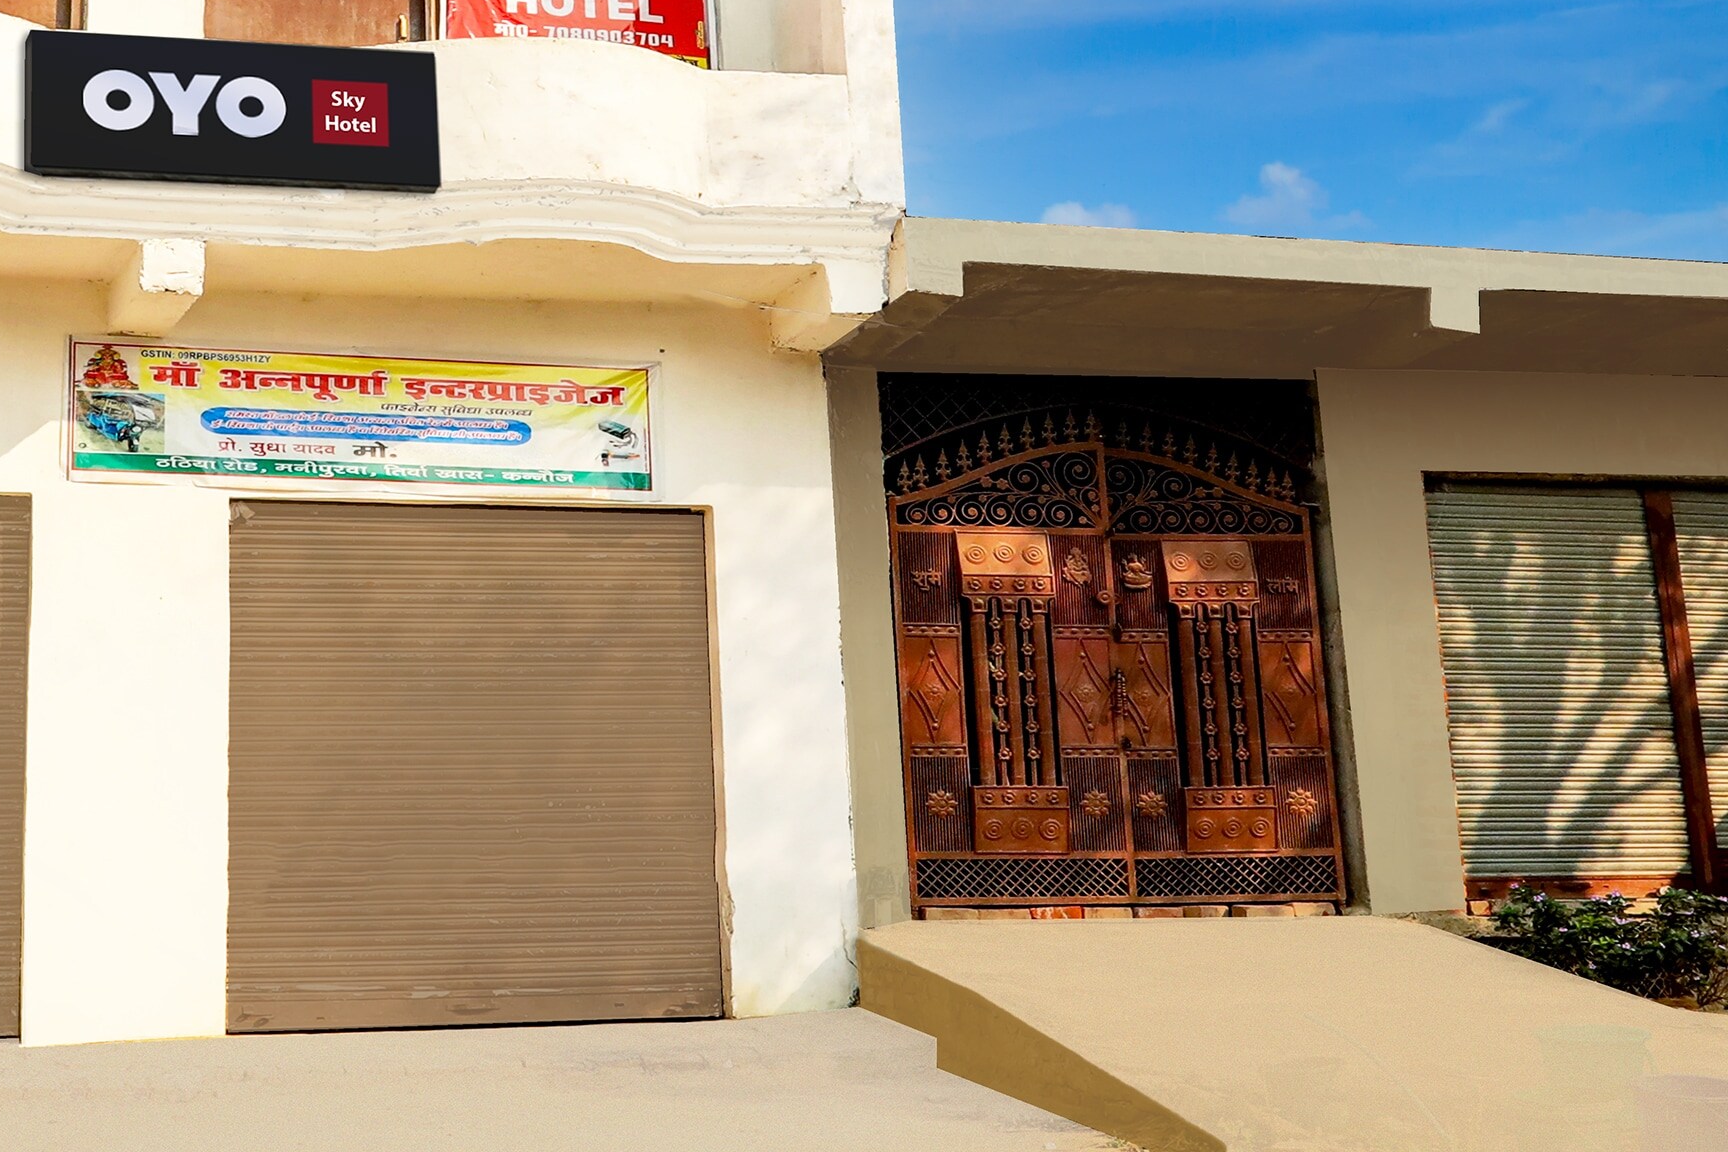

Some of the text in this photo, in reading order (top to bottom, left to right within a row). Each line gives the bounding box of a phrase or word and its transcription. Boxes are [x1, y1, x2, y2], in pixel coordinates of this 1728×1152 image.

[83, 69, 287, 138] OYO
[331, 90, 366, 112] Sky
[325, 115, 377, 134] Hotel
[141, 349, 176, 359] GSTIN:
[219, 368, 388, 401] अन्नपूर्णा
[401, 378, 625, 406] इन्टरप्राइजेज
[441, 404, 481, 415] सुविधा
[249, 441, 286, 456] सुधा
[293, 443, 335, 455] यादव
[156, 456, 216, 470] ठठिया
